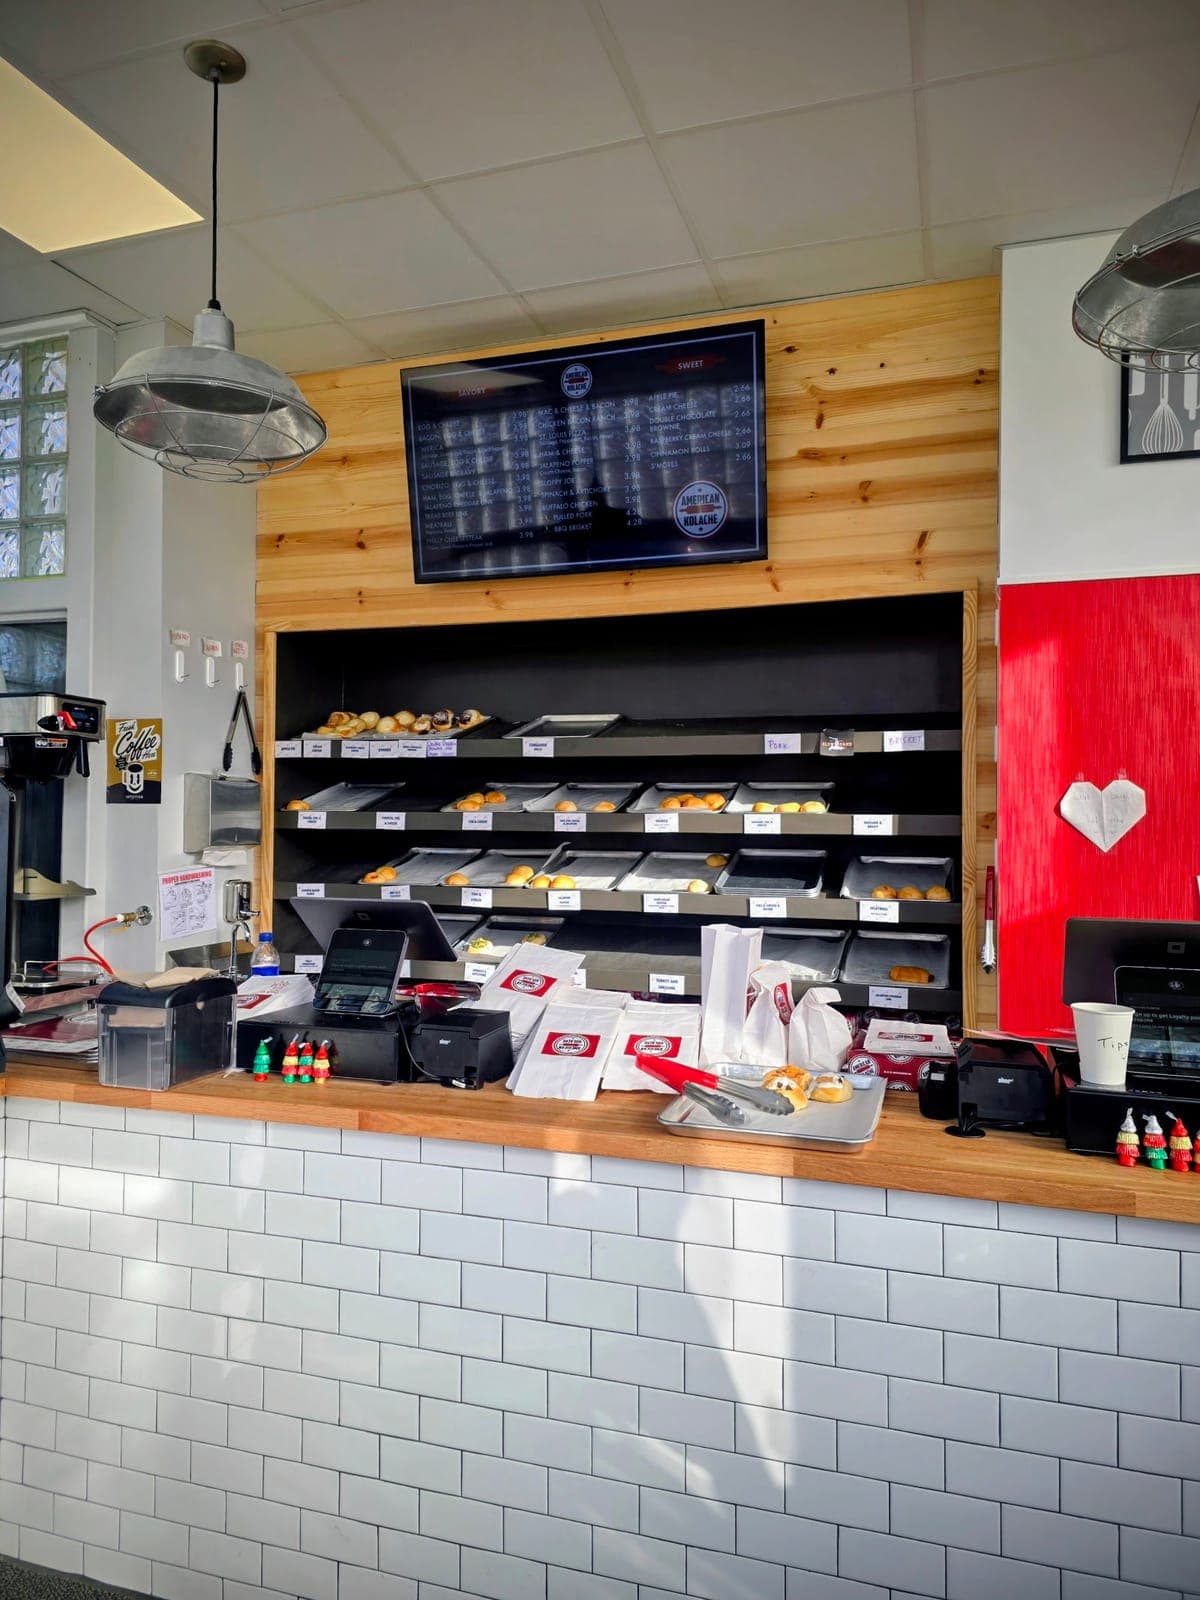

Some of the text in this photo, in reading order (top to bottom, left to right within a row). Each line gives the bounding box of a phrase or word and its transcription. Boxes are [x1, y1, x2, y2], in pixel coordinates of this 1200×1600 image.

[677, 359, 703, 369] SWEET
[458, 386, 486, 397] SAVORY
[676, 411, 715, 421] CHOCOLATE
[681, 493, 719, 505] AMERICAN
[683, 514, 717, 526] KOLACHE
[115, 727, 158, 760] Coffee
[162, 870, 212, 885] PROPER HANDWASHING
[1097, 1037, 1129, 1052] Tips
